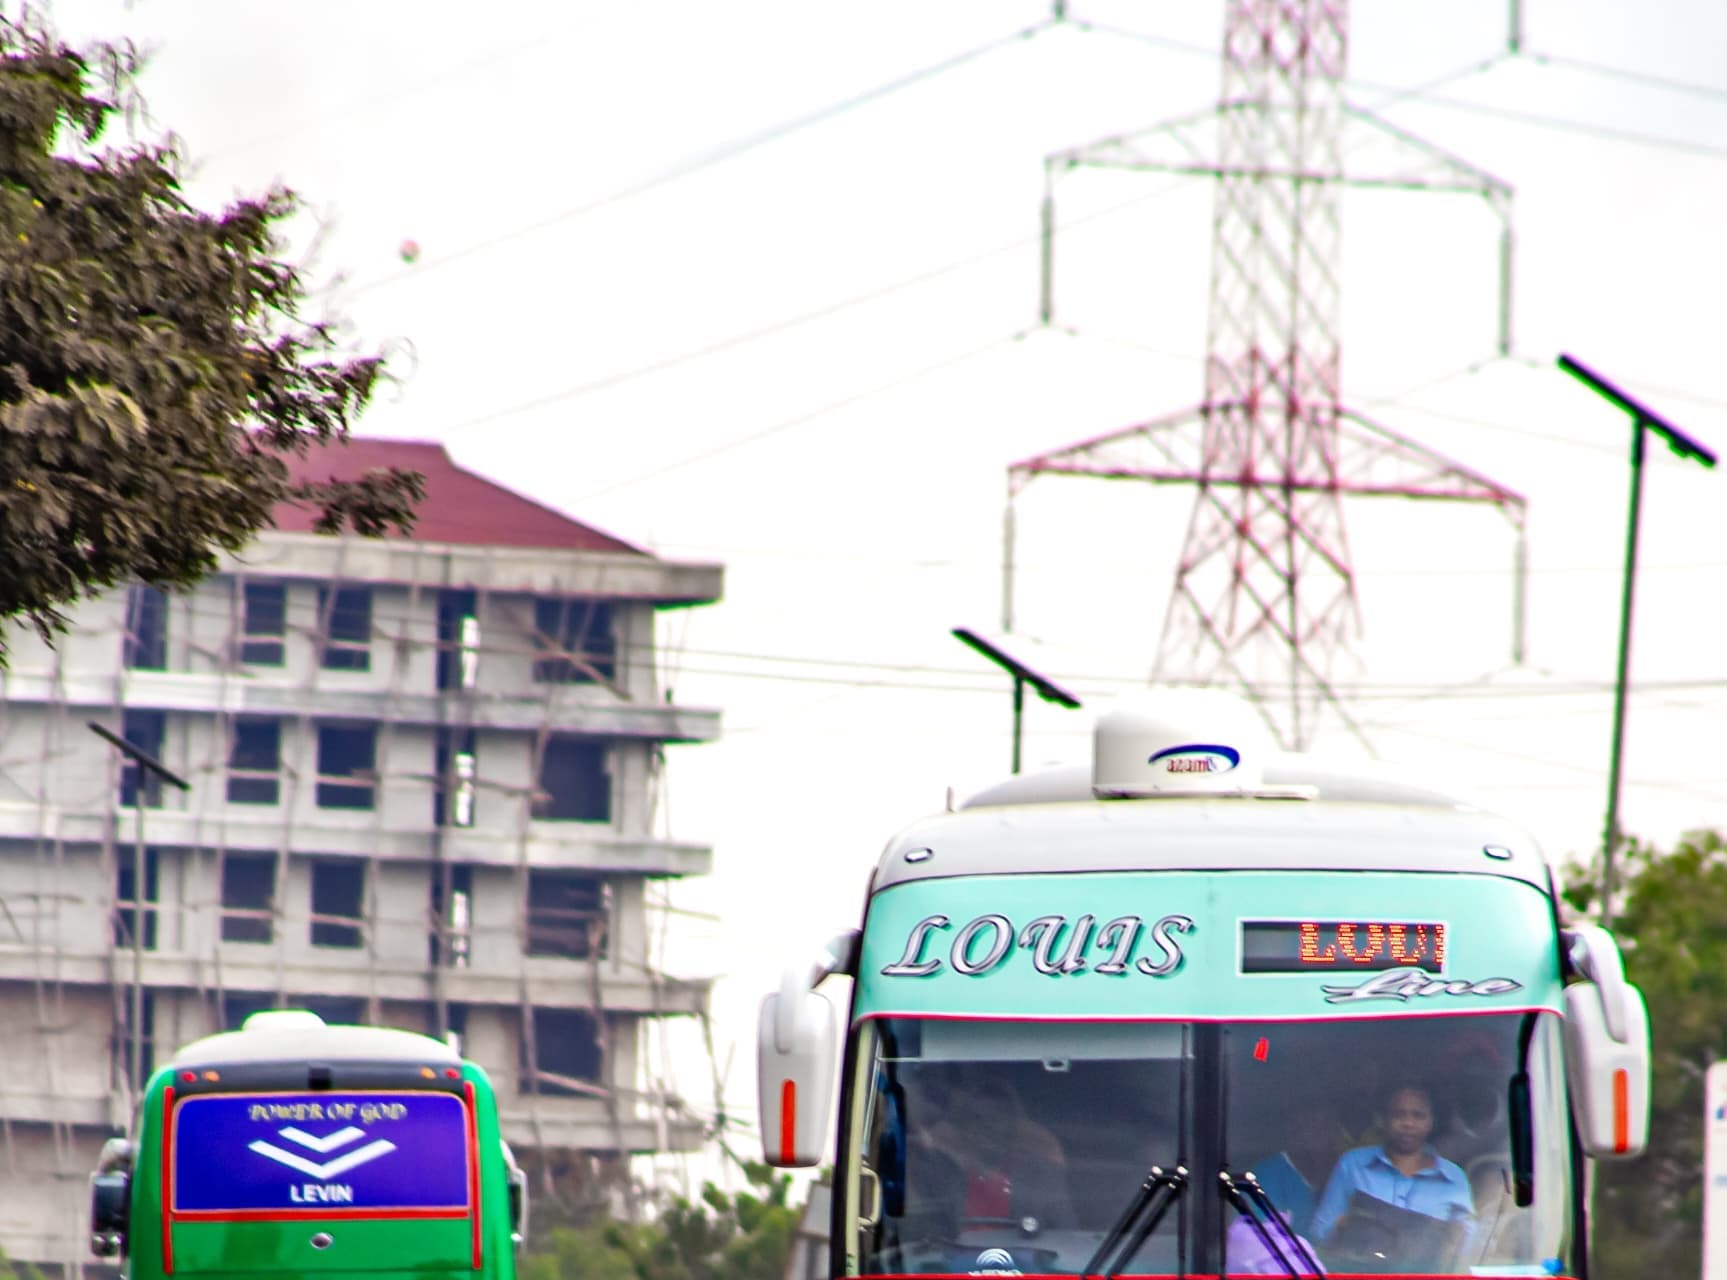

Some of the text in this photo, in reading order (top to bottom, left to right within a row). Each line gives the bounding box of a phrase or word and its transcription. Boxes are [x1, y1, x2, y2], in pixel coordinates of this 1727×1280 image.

[880, 913, 1194, 977] LOUIS
[249, 1102, 408, 1125] POWER OF GOD
[289, 1183, 355, 1203] LEVIN
